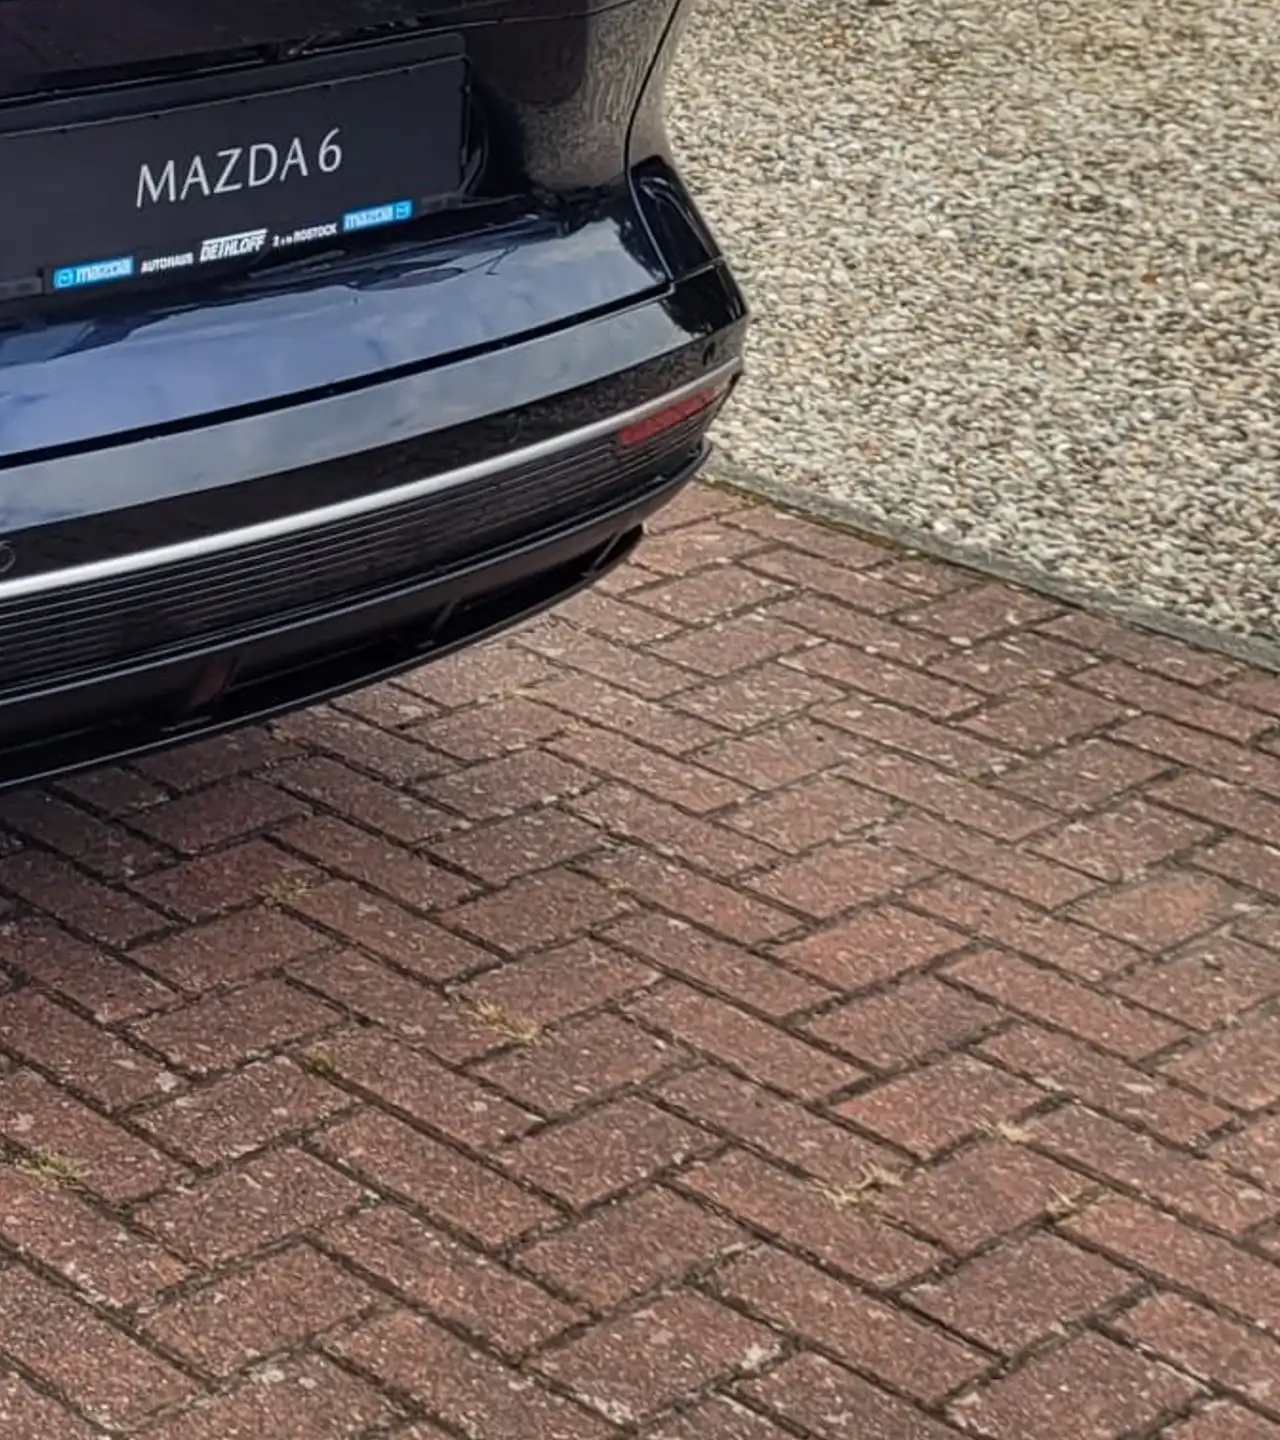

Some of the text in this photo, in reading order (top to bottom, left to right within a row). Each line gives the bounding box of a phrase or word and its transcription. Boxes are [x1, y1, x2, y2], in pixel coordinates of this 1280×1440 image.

[75, 256, 134, 284] mazda
[141, 252, 194, 274] AUTOHAUS
[200, 227, 269, 263] DETHLOFF
[293, 222, 338, 243] ROSTOCK
[343, 204, 394, 232] mazda
